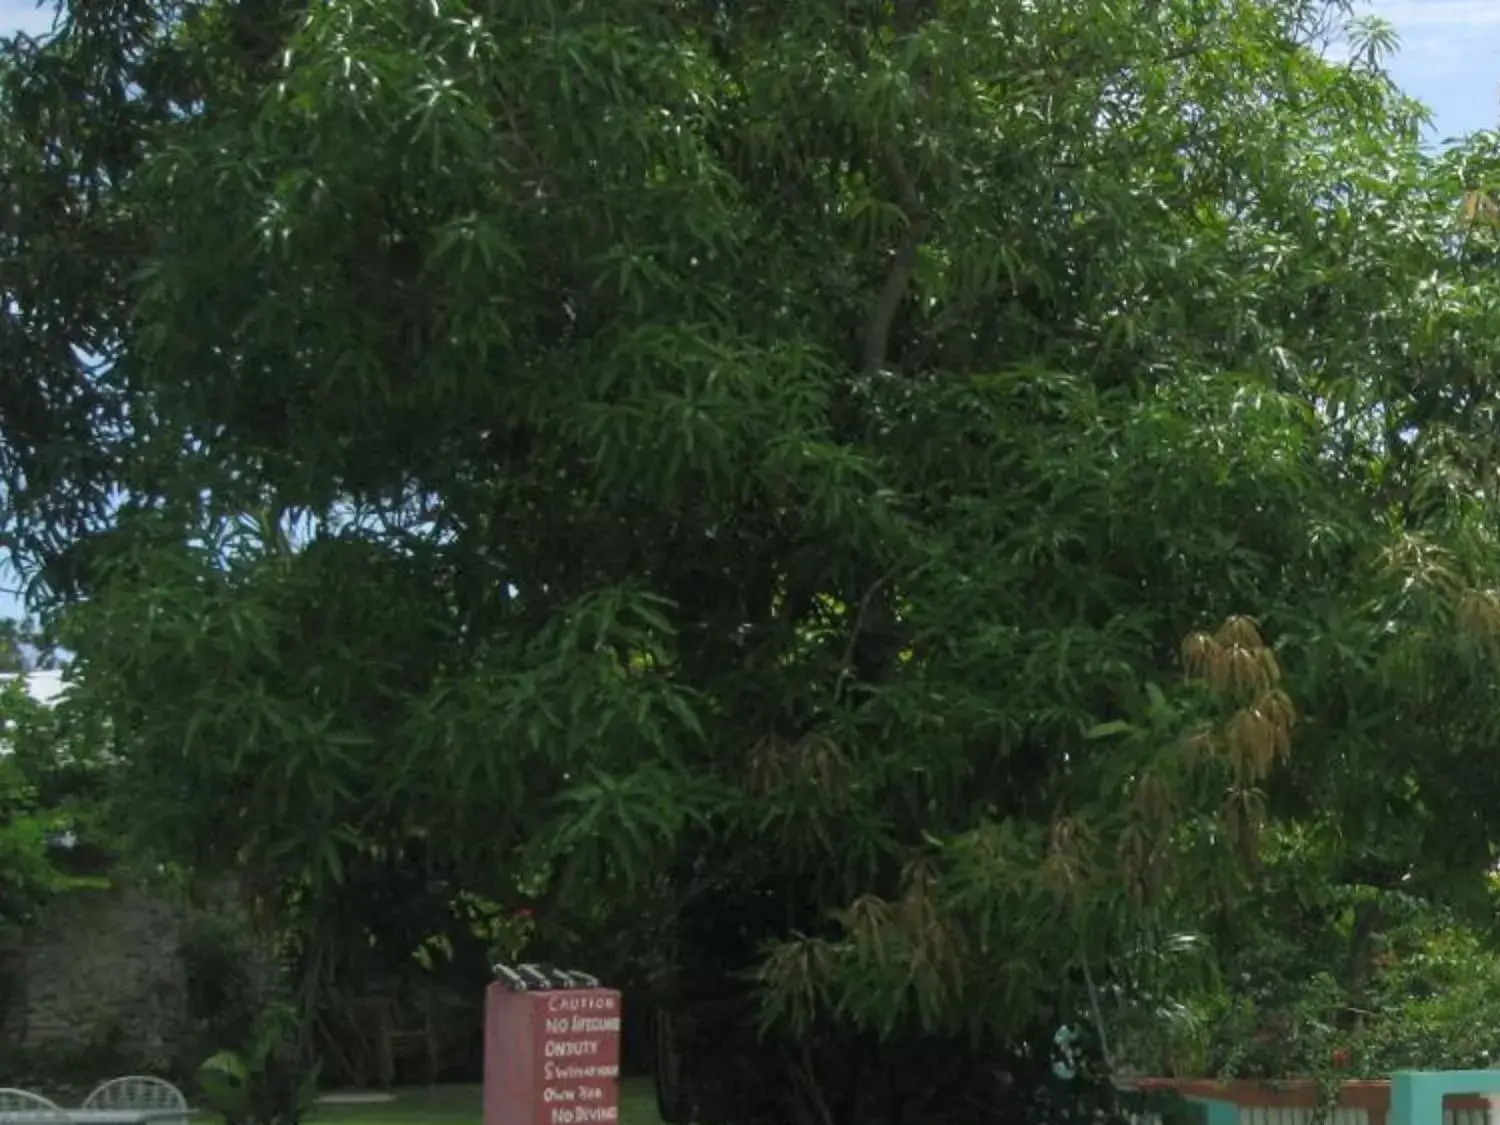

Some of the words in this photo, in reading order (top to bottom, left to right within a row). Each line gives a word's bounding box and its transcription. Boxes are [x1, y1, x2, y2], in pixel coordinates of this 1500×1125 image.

[549, 995, 614, 1012] CAUTION
[546, 1018, 569, 1033] NO
[575, 1106, 617, 1122] DIVING
